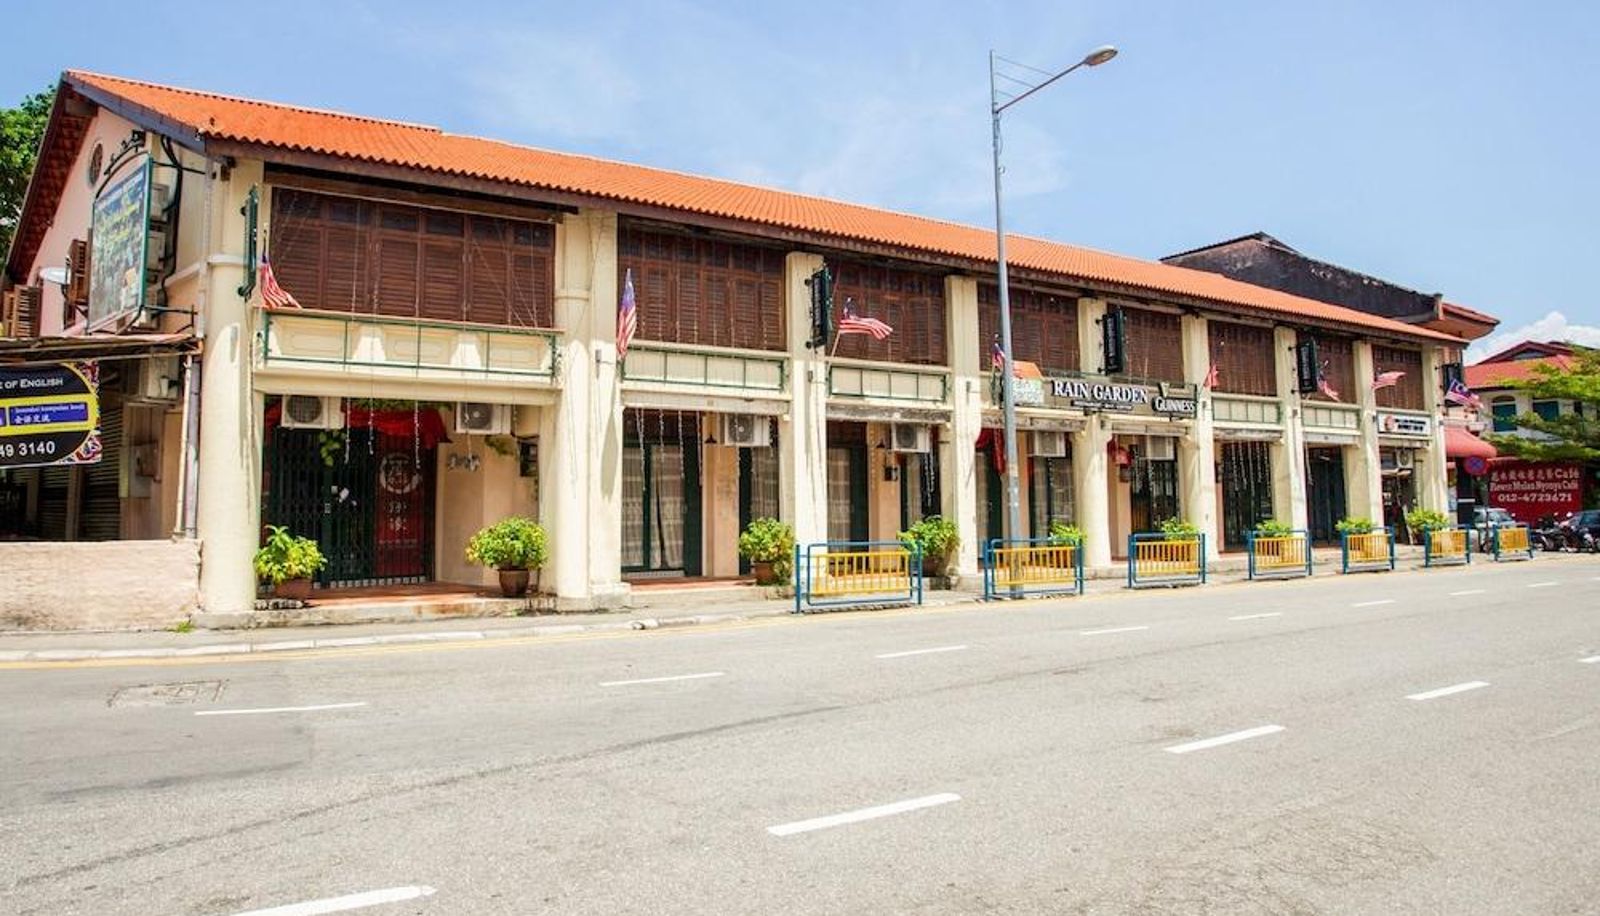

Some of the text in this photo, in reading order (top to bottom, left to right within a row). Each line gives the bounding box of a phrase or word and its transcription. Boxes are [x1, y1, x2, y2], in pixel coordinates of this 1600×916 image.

[4, 380, 18, 389] OF
[20, 378, 63, 388] ENGLISH
[1053, 380, 1089, 398] RAIN
[1093, 384, 1149, 403] GARDEN
[1155, 396, 1195, 412] GUINNESS
[18, 441, 55, 456] 3140
[1498, 493, 1572, 502] 012-4723671
